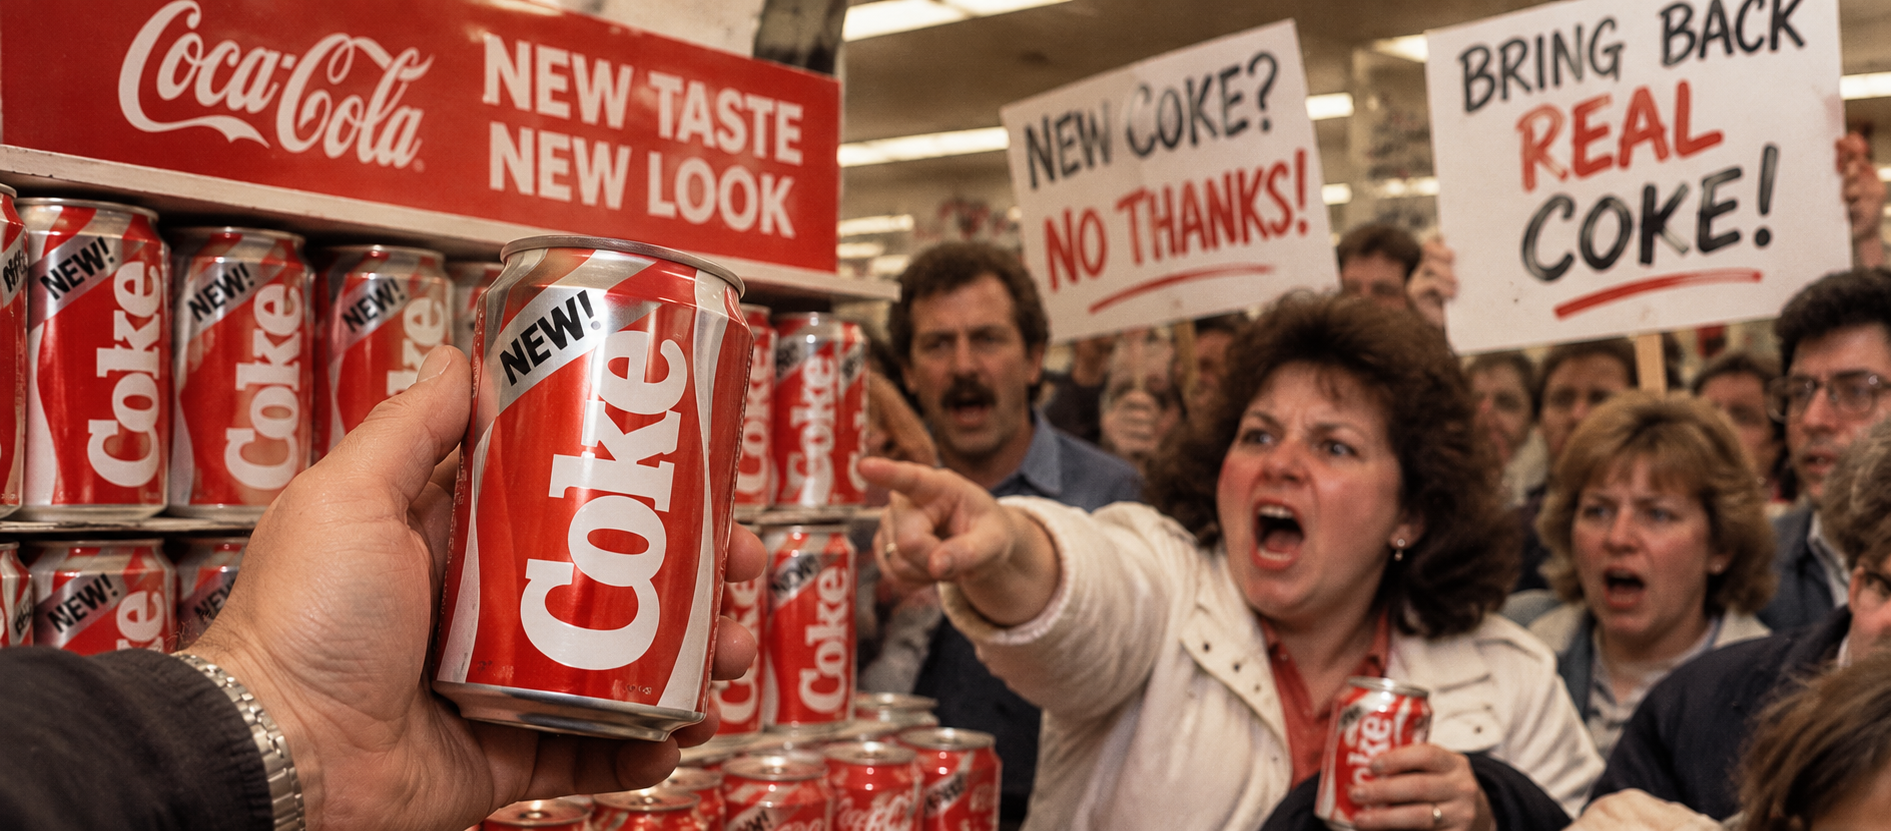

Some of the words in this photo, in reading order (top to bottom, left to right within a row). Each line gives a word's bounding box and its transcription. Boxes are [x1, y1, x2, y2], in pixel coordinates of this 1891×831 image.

[118, 0, 434, 169] Coca-Cola
[483, 33, 634, 130] NEW
[648, 70, 804, 166] TASTE
[1024, 102, 1111, 190] NEW
[1125, 52, 1278, 158] COKE?
[1459, 17, 1624, 114] BRING
[1659, 0, 1804, 68] BACK
[489, 121, 632, 210] NEW
[647, 151, 796, 239] LOOK
[1515, 80, 1724, 192] REAL
[40, 236, 115, 300] NEW!
[1044, 206, 1108, 292] NO
[1115, 147, 1308, 267] THANKS!
[1521, 143, 1779, 283] COKE!
[187, 262, 255, 322] NEW!
[342, 278, 405, 333] NEW!
[499, 290, 600, 387] NEW!
[87, 261, 162, 488] Coke
[224, 283, 301, 490] Coke
[520, 330, 688, 671] Coke
[47, 573, 119, 633] NEW!
[798, 566, 849, 714] Coke
